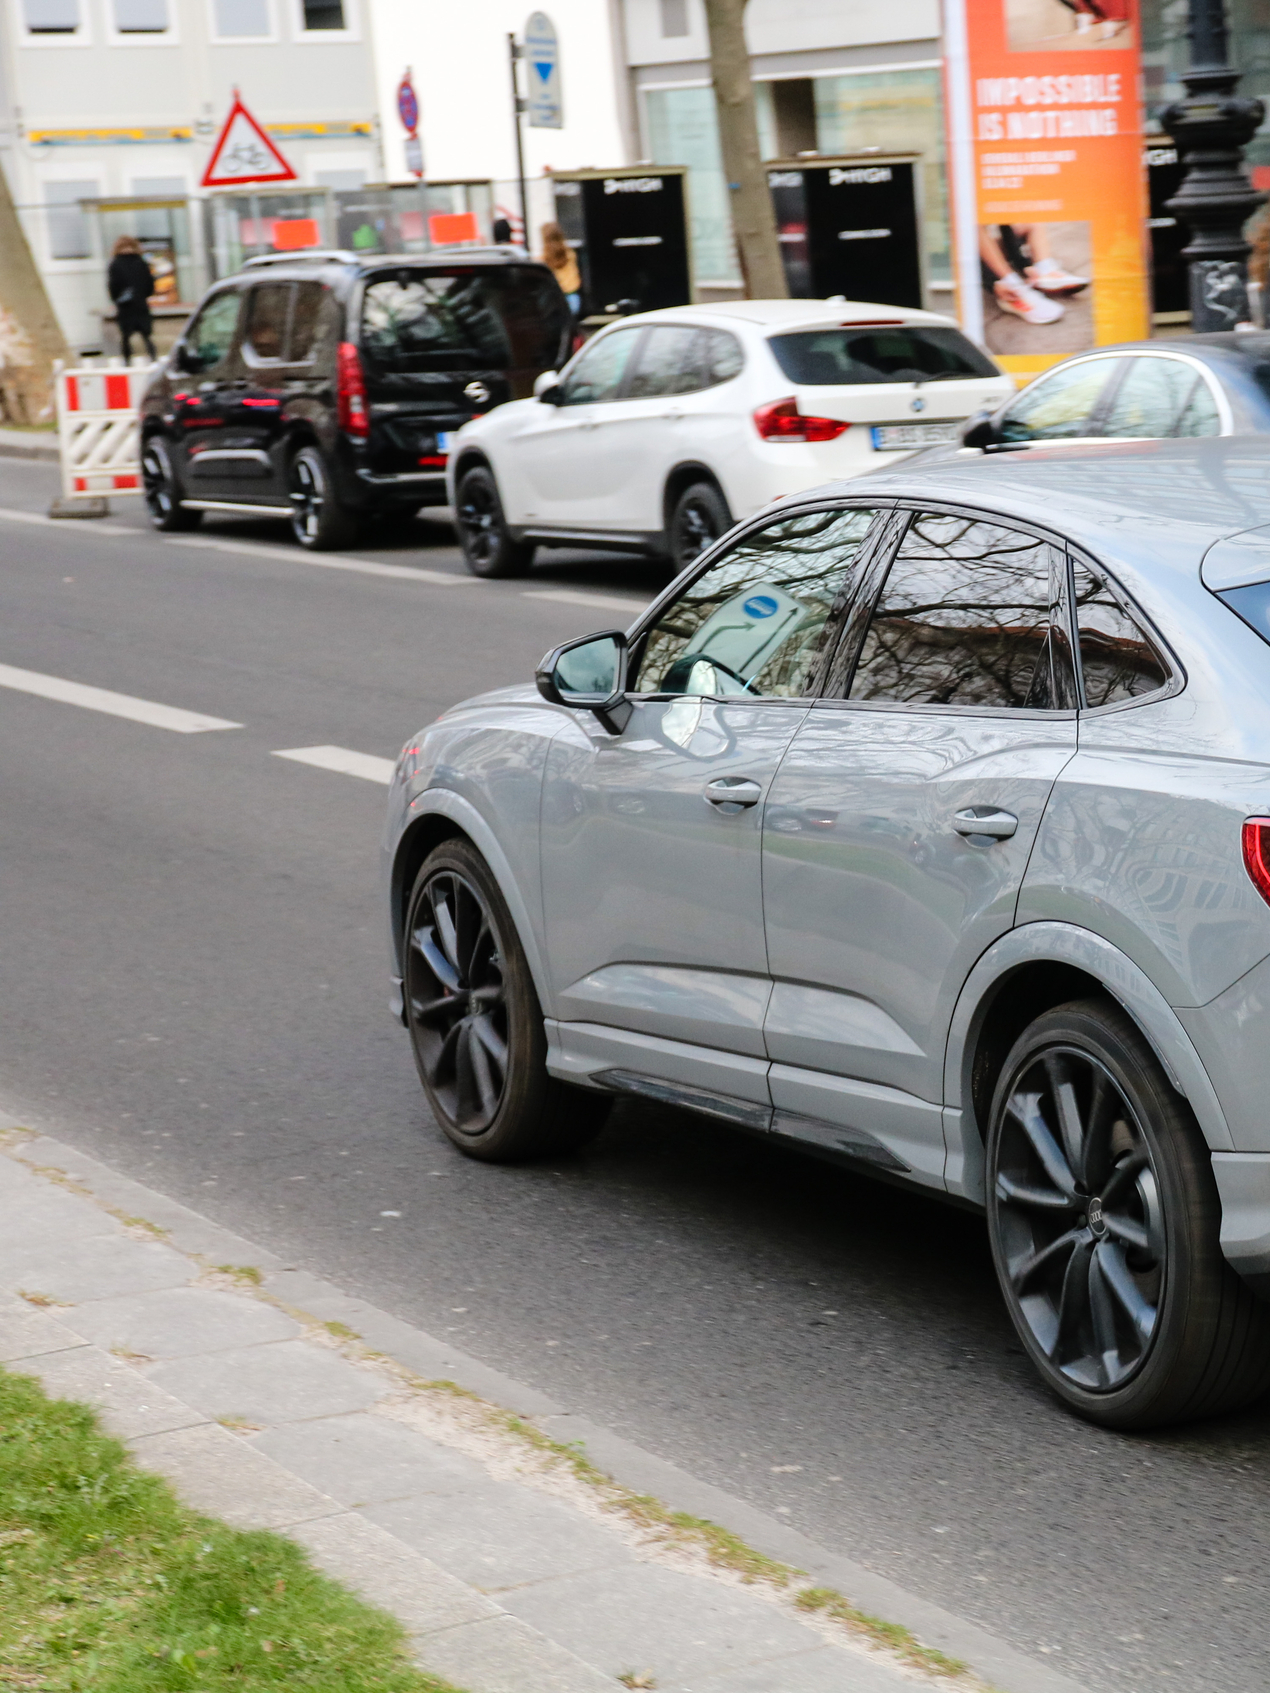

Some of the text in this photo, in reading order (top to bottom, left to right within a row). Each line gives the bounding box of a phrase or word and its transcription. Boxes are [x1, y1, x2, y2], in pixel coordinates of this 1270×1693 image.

[976, 74, 1122, 107] IMPOSSIBLE
[977, 108, 1119, 141] IS NOTHING
